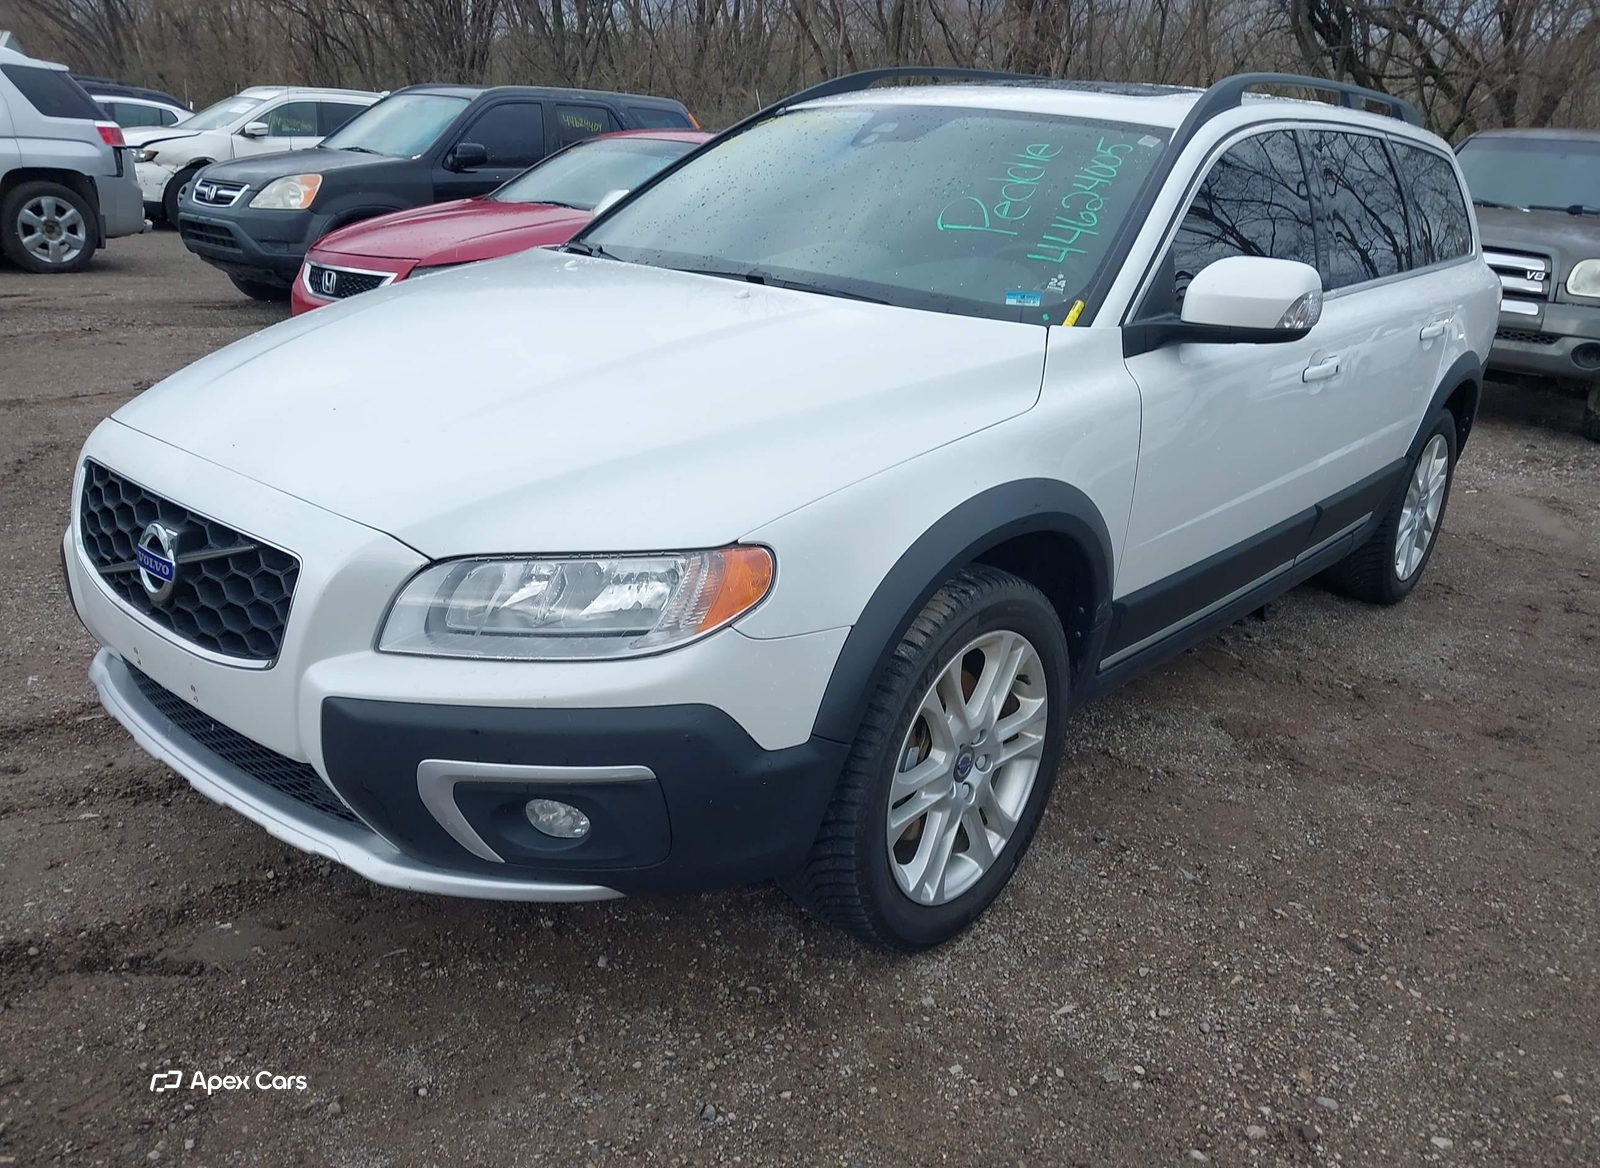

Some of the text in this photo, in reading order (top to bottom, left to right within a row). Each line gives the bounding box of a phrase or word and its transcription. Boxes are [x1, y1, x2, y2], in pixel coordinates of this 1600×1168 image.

[937, 143, 1063, 236] Peddle
[1027, 136, 1134, 263] 44624005
[1049, 277, 1067, 288] 24
[1526, 270, 1546, 281] V8
[138, 550, 170, 576] VOLVO
